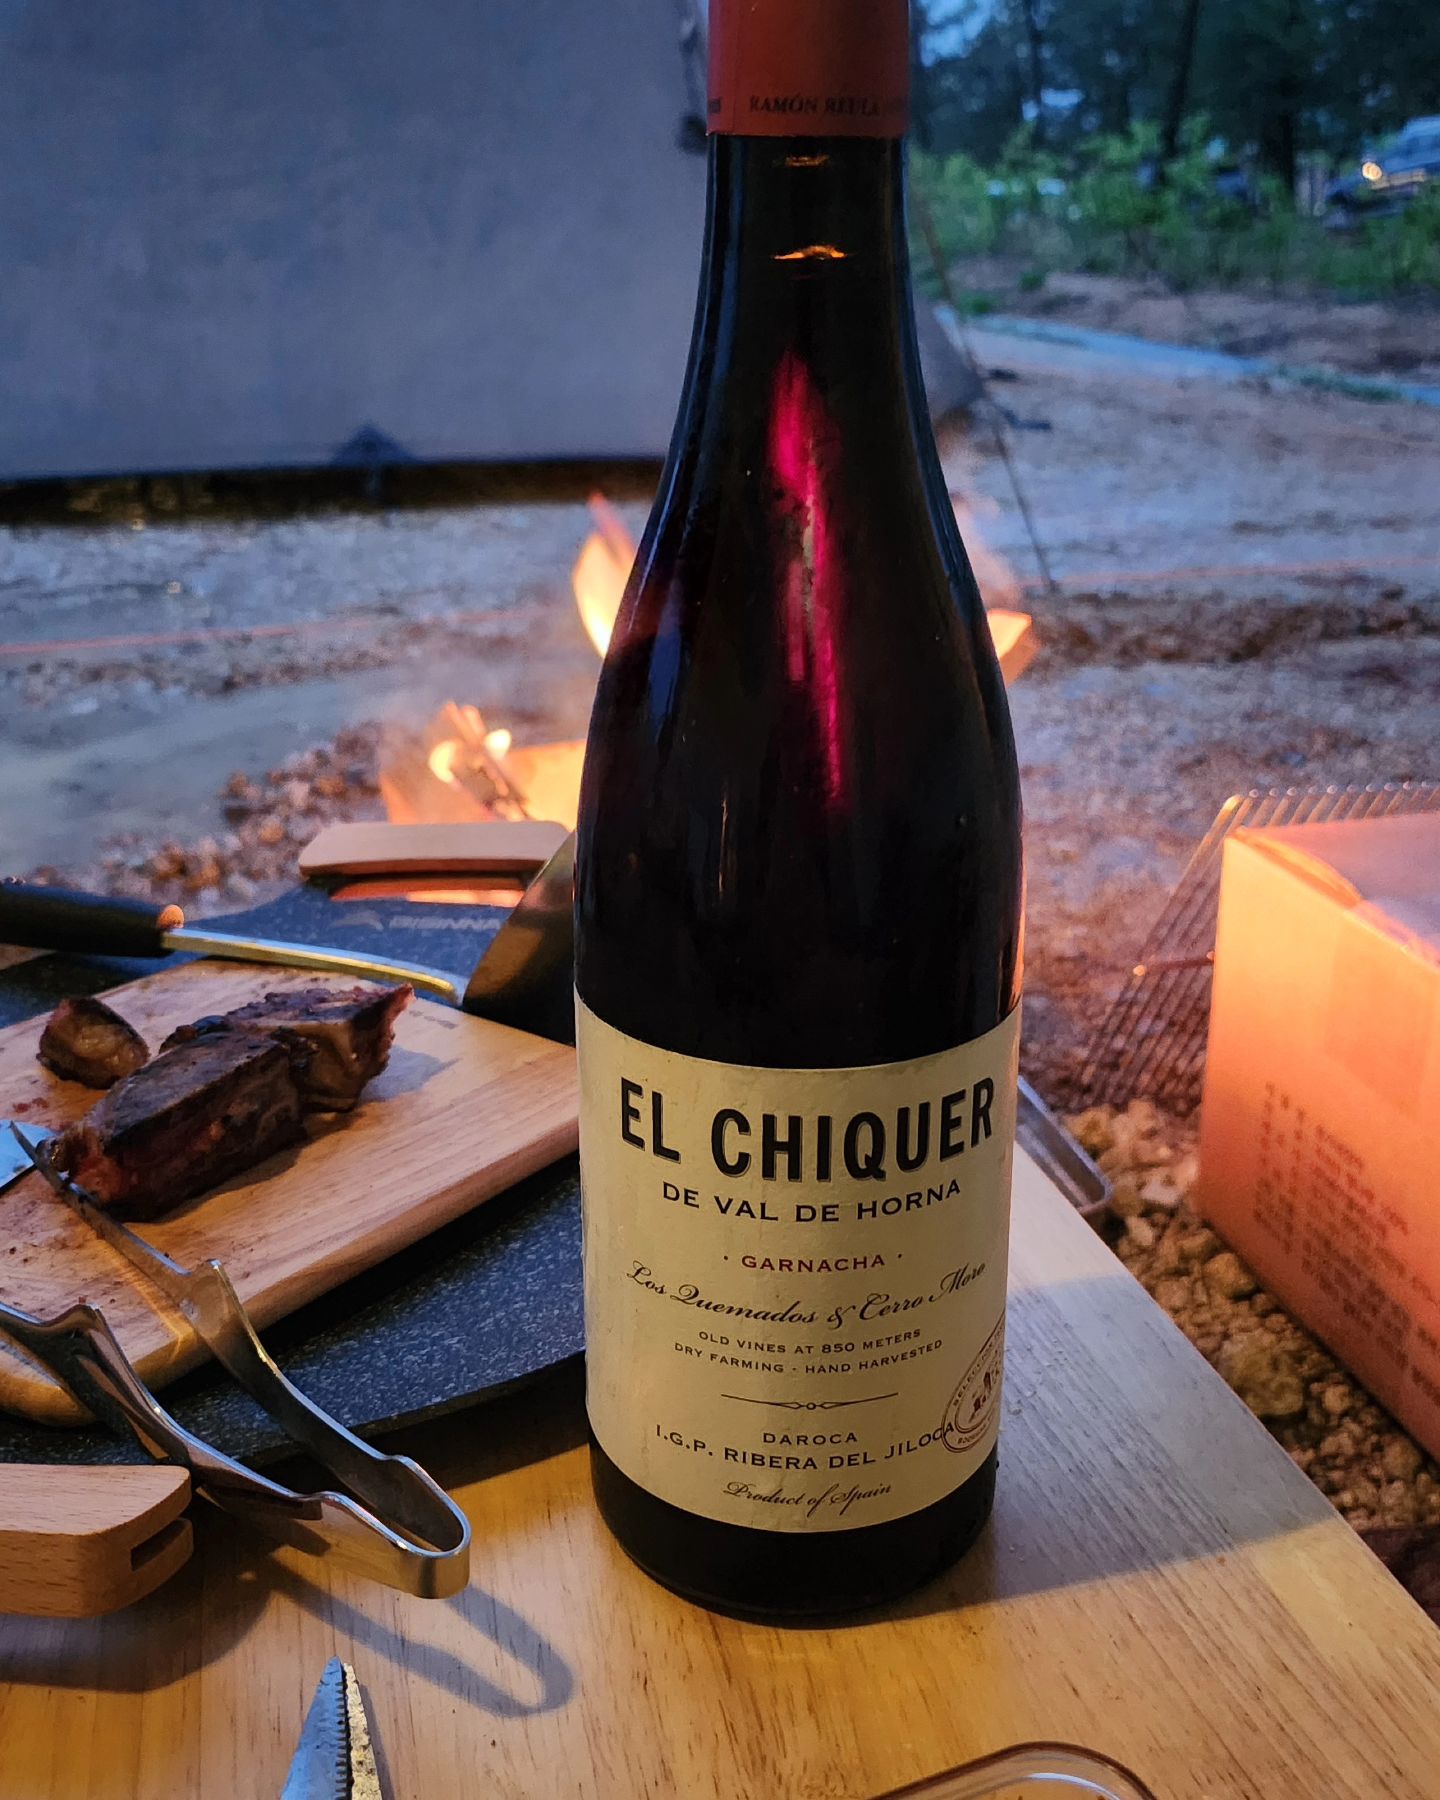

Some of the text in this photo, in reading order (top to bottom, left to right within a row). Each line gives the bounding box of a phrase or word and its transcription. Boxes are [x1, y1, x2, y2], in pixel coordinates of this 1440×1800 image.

[620, 1076, 995, 1183] EL CHIQUER
[662, 1178, 962, 1223] DE VAL DE HORNA
[741, 1254, 886, 1273] GARNACHA
[626, 1260, 987, 1330] Los Quemados & Cerro Moro
[674, 1339, 943, 1374] DRY FARMING HAND HARVESTED
[699, 1328, 921, 1355] OLD VINES AT 850 METERS
[656, 1424, 714, 1457] I.G.P.
[724, 1447, 817, 1470] RIBERA
[829, 1451, 876, 1469] DEL
[884, 1421, 955, 1460] JILOCA
[763, 1432, 858, 1446] DAROCA
[723, 1481, 892, 1518] Product of Spain
